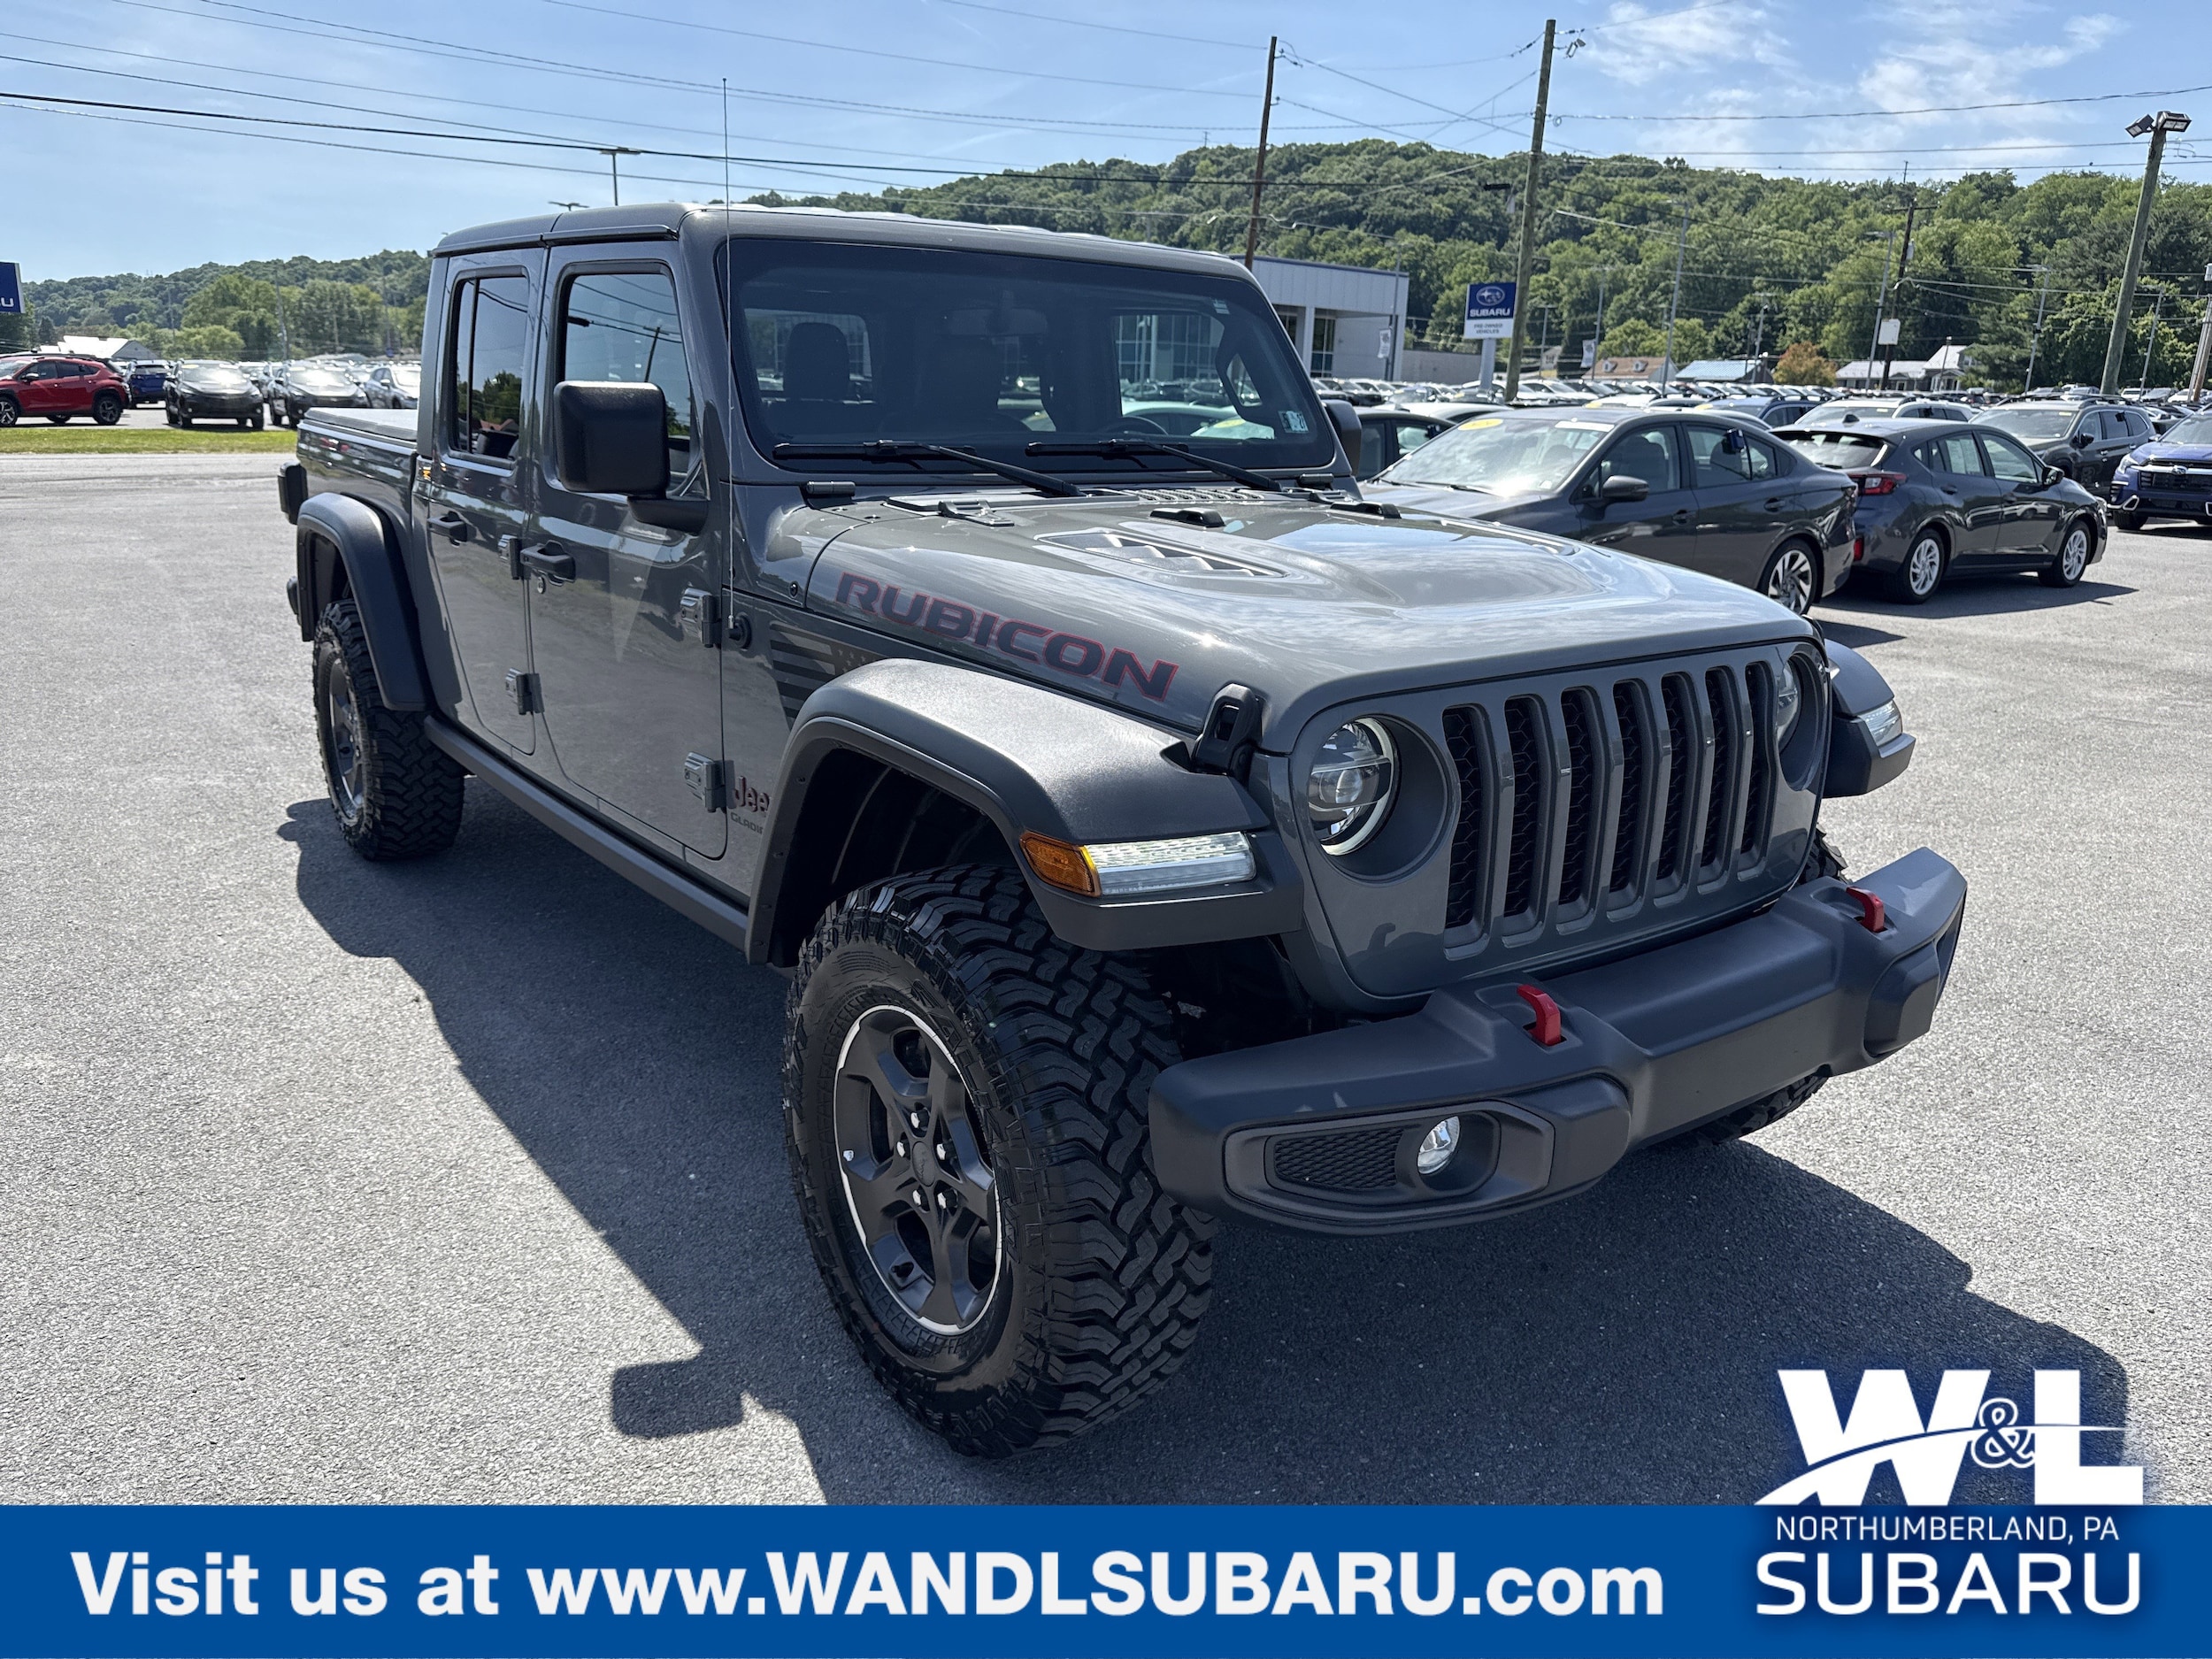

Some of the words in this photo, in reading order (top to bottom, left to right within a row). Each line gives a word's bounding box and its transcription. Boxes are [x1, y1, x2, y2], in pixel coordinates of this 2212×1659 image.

[1470, 308, 1510, 317] SUBARU
[835, 572, 1179, 702] RUBICON
[733, 775, 771, 814] Jee
